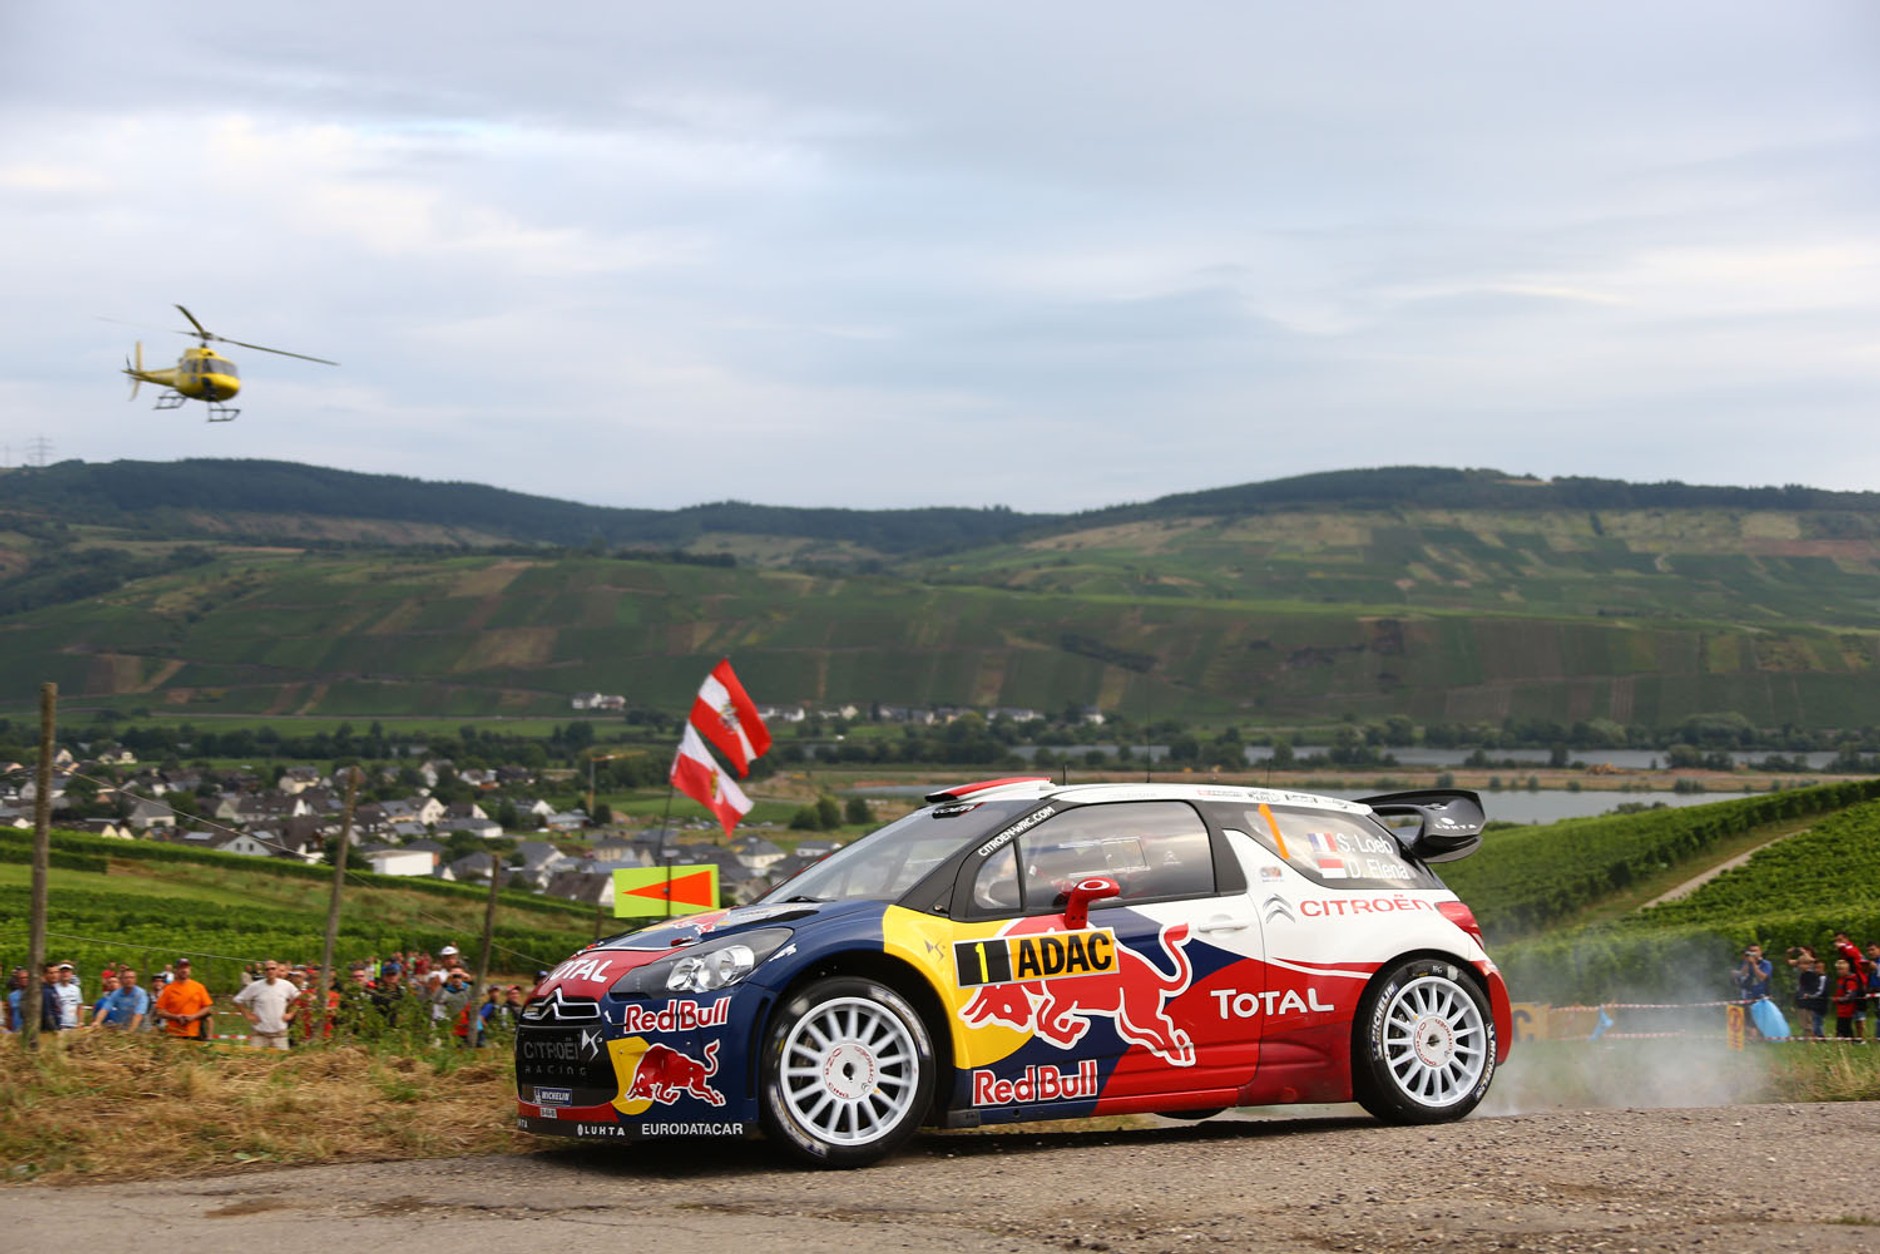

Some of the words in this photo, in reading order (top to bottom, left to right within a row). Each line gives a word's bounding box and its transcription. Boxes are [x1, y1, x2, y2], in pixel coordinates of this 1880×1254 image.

[978, 806, 1056, 856] CITROEN-WRC.COM
[1356, 834, 1394, 854] Loeb
[1367, 861, 1411, 880] Elena
[975, 942, 989, 983] 1
[1018, 933, 1112, 978] ADAC
[624, 999, 677, 1034] Red
[678, 996, 732, 1031] Bull
[1210, 988, 1335, 1020] TOTAL
[973, 1065, 1035, 1106] Red
[1038, 1060, 1097, 1100] Bull
[584, 1126, 625, 1136] LUHTA
[641, 1123, 743, 1136] EURODATACAR
